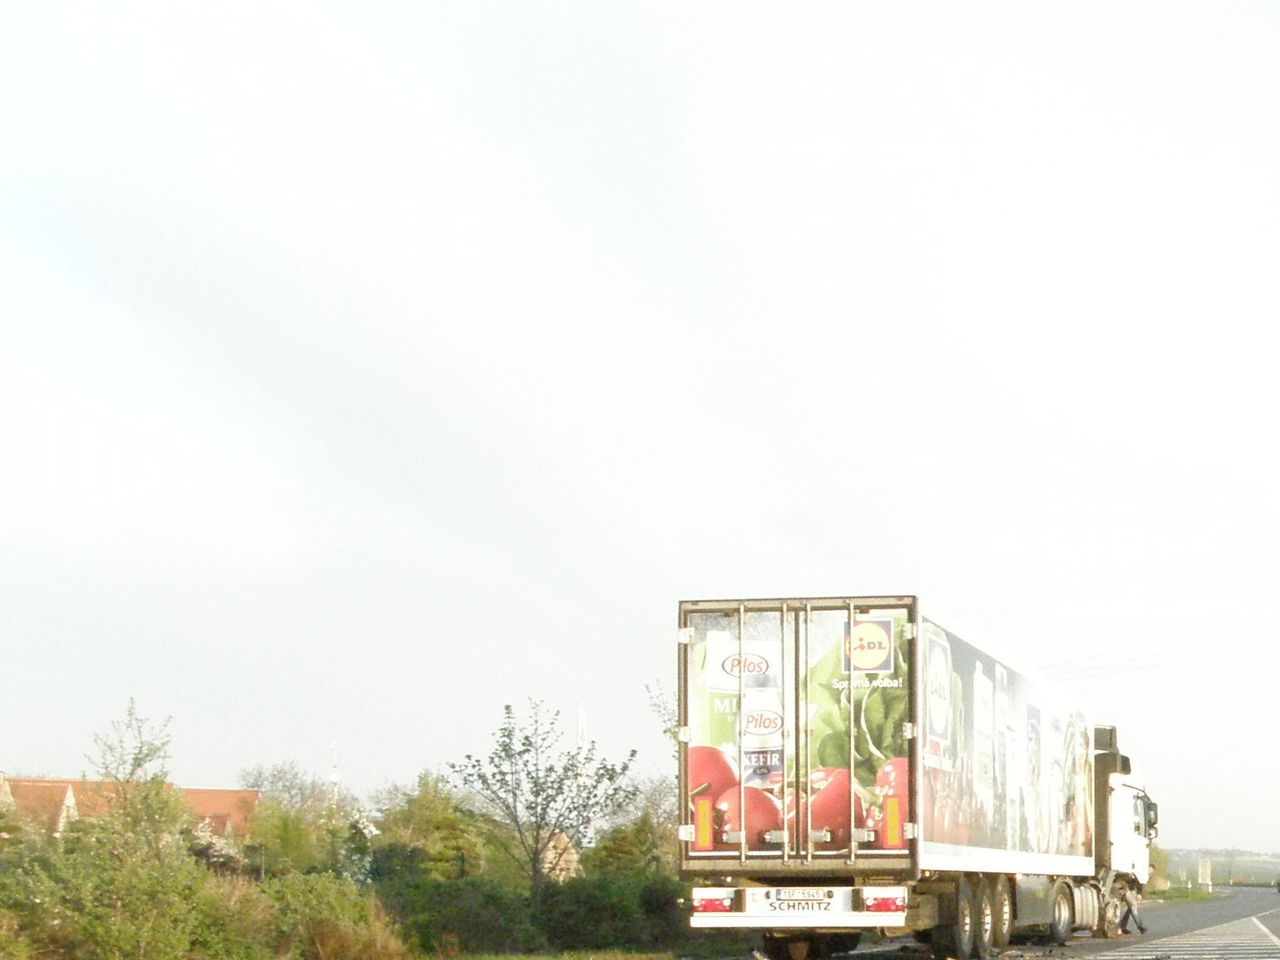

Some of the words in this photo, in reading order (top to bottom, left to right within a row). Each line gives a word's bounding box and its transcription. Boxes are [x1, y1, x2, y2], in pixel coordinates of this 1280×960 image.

[730, 656, 764, 673] Plos
[746, 713, 778, 729] Pilos
[769, 901, 831, 911] SCHMITZ
